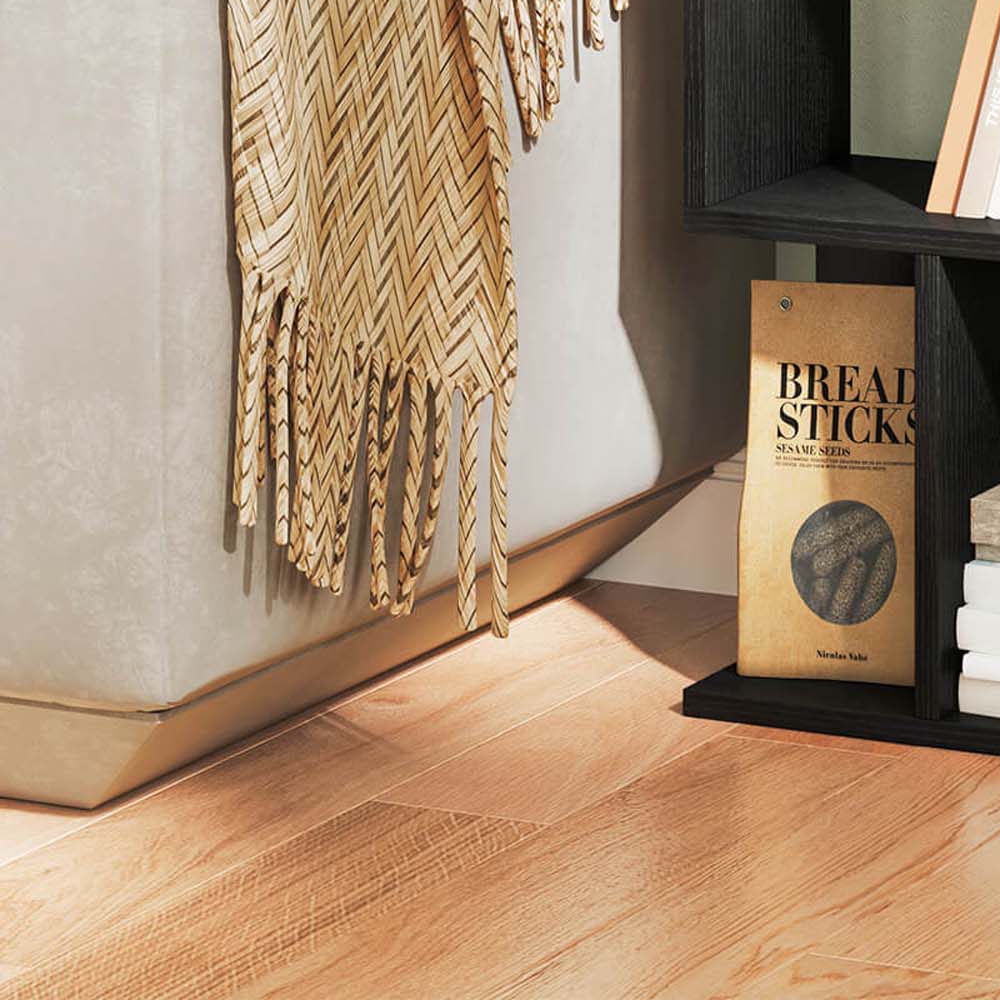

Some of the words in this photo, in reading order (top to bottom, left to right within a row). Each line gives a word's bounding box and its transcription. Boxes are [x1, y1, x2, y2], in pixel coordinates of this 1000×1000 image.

[776, 361, 916, 404] BREAD
[776, 443, 816, 456] SESAME
[819, 446, 851, 457] SEEDS
